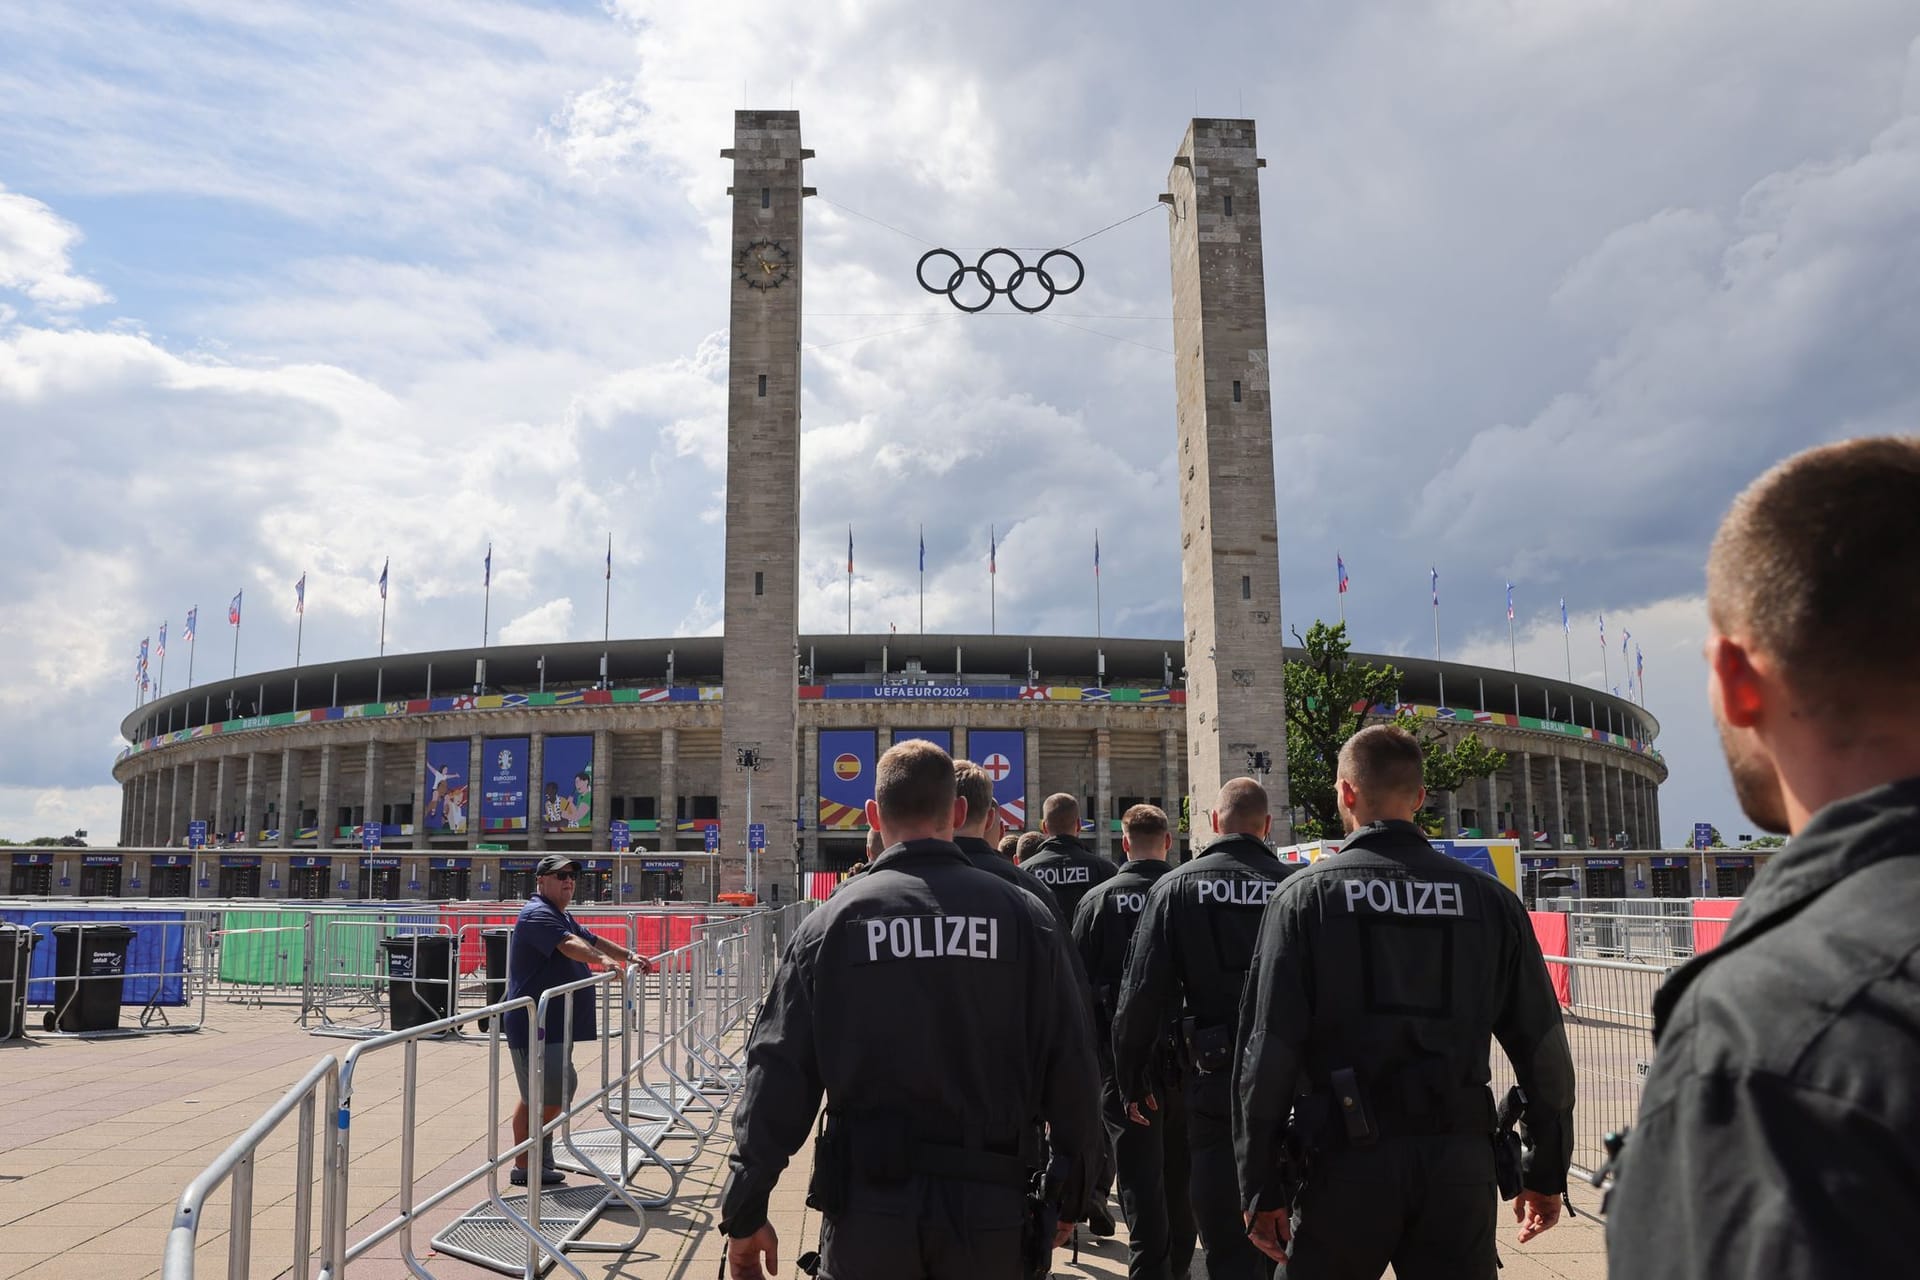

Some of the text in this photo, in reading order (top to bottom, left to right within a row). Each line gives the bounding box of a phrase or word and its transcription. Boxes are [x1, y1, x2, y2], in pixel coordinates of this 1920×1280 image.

[242, 716, 270, 729] BERLIN
[1540, 720, 1566, 733] BERLIN
[1035, 866, 1090, 885] POLIZEI
[1197, 879, 1281, 905] POLIZE
[1343, 879, 1464, 916] POLIZEI
[866, 916, 998, 961] POLIZEI
